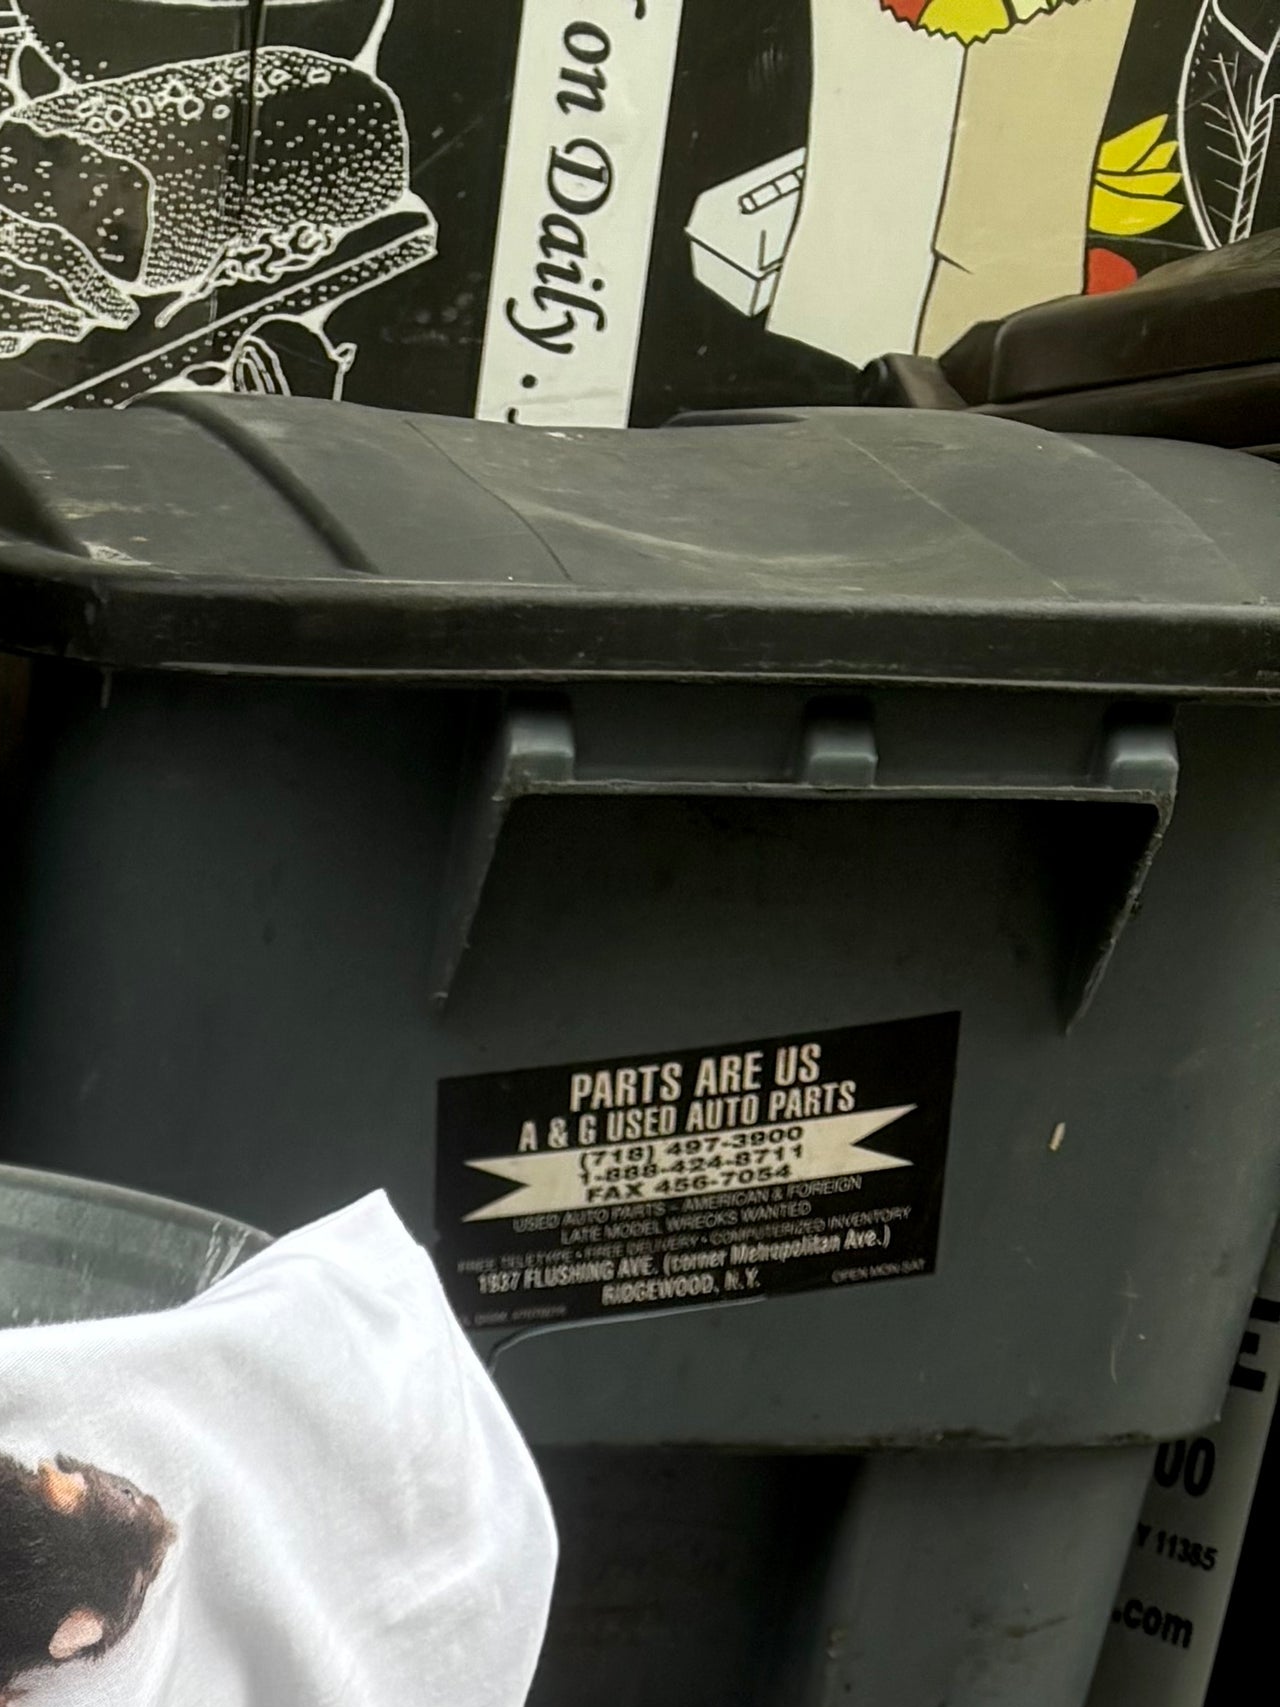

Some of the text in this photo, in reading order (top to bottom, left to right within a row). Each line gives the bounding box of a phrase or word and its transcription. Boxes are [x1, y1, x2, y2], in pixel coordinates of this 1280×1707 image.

[557, 20, 611, 114] on
[570, 1042, 822, 1113] PARTS ARE US
[518, 1080, 856, 1153] A & G USED AUTO PARTS
[579, 1143, 654, 1172] (718)
[585, 1162, 792, 1204] FAX 456-7054
[560, 1199, 812, 1247] LATE MODEL WRECKS WANTED
[561, 1208, 609, 1228] AUTO
[681, 1187, 769, 1212] AMERICAN
[786, 1174, 862, 1198] FOREIGN
[523, 1258, 614, 1292] FLUSHING
